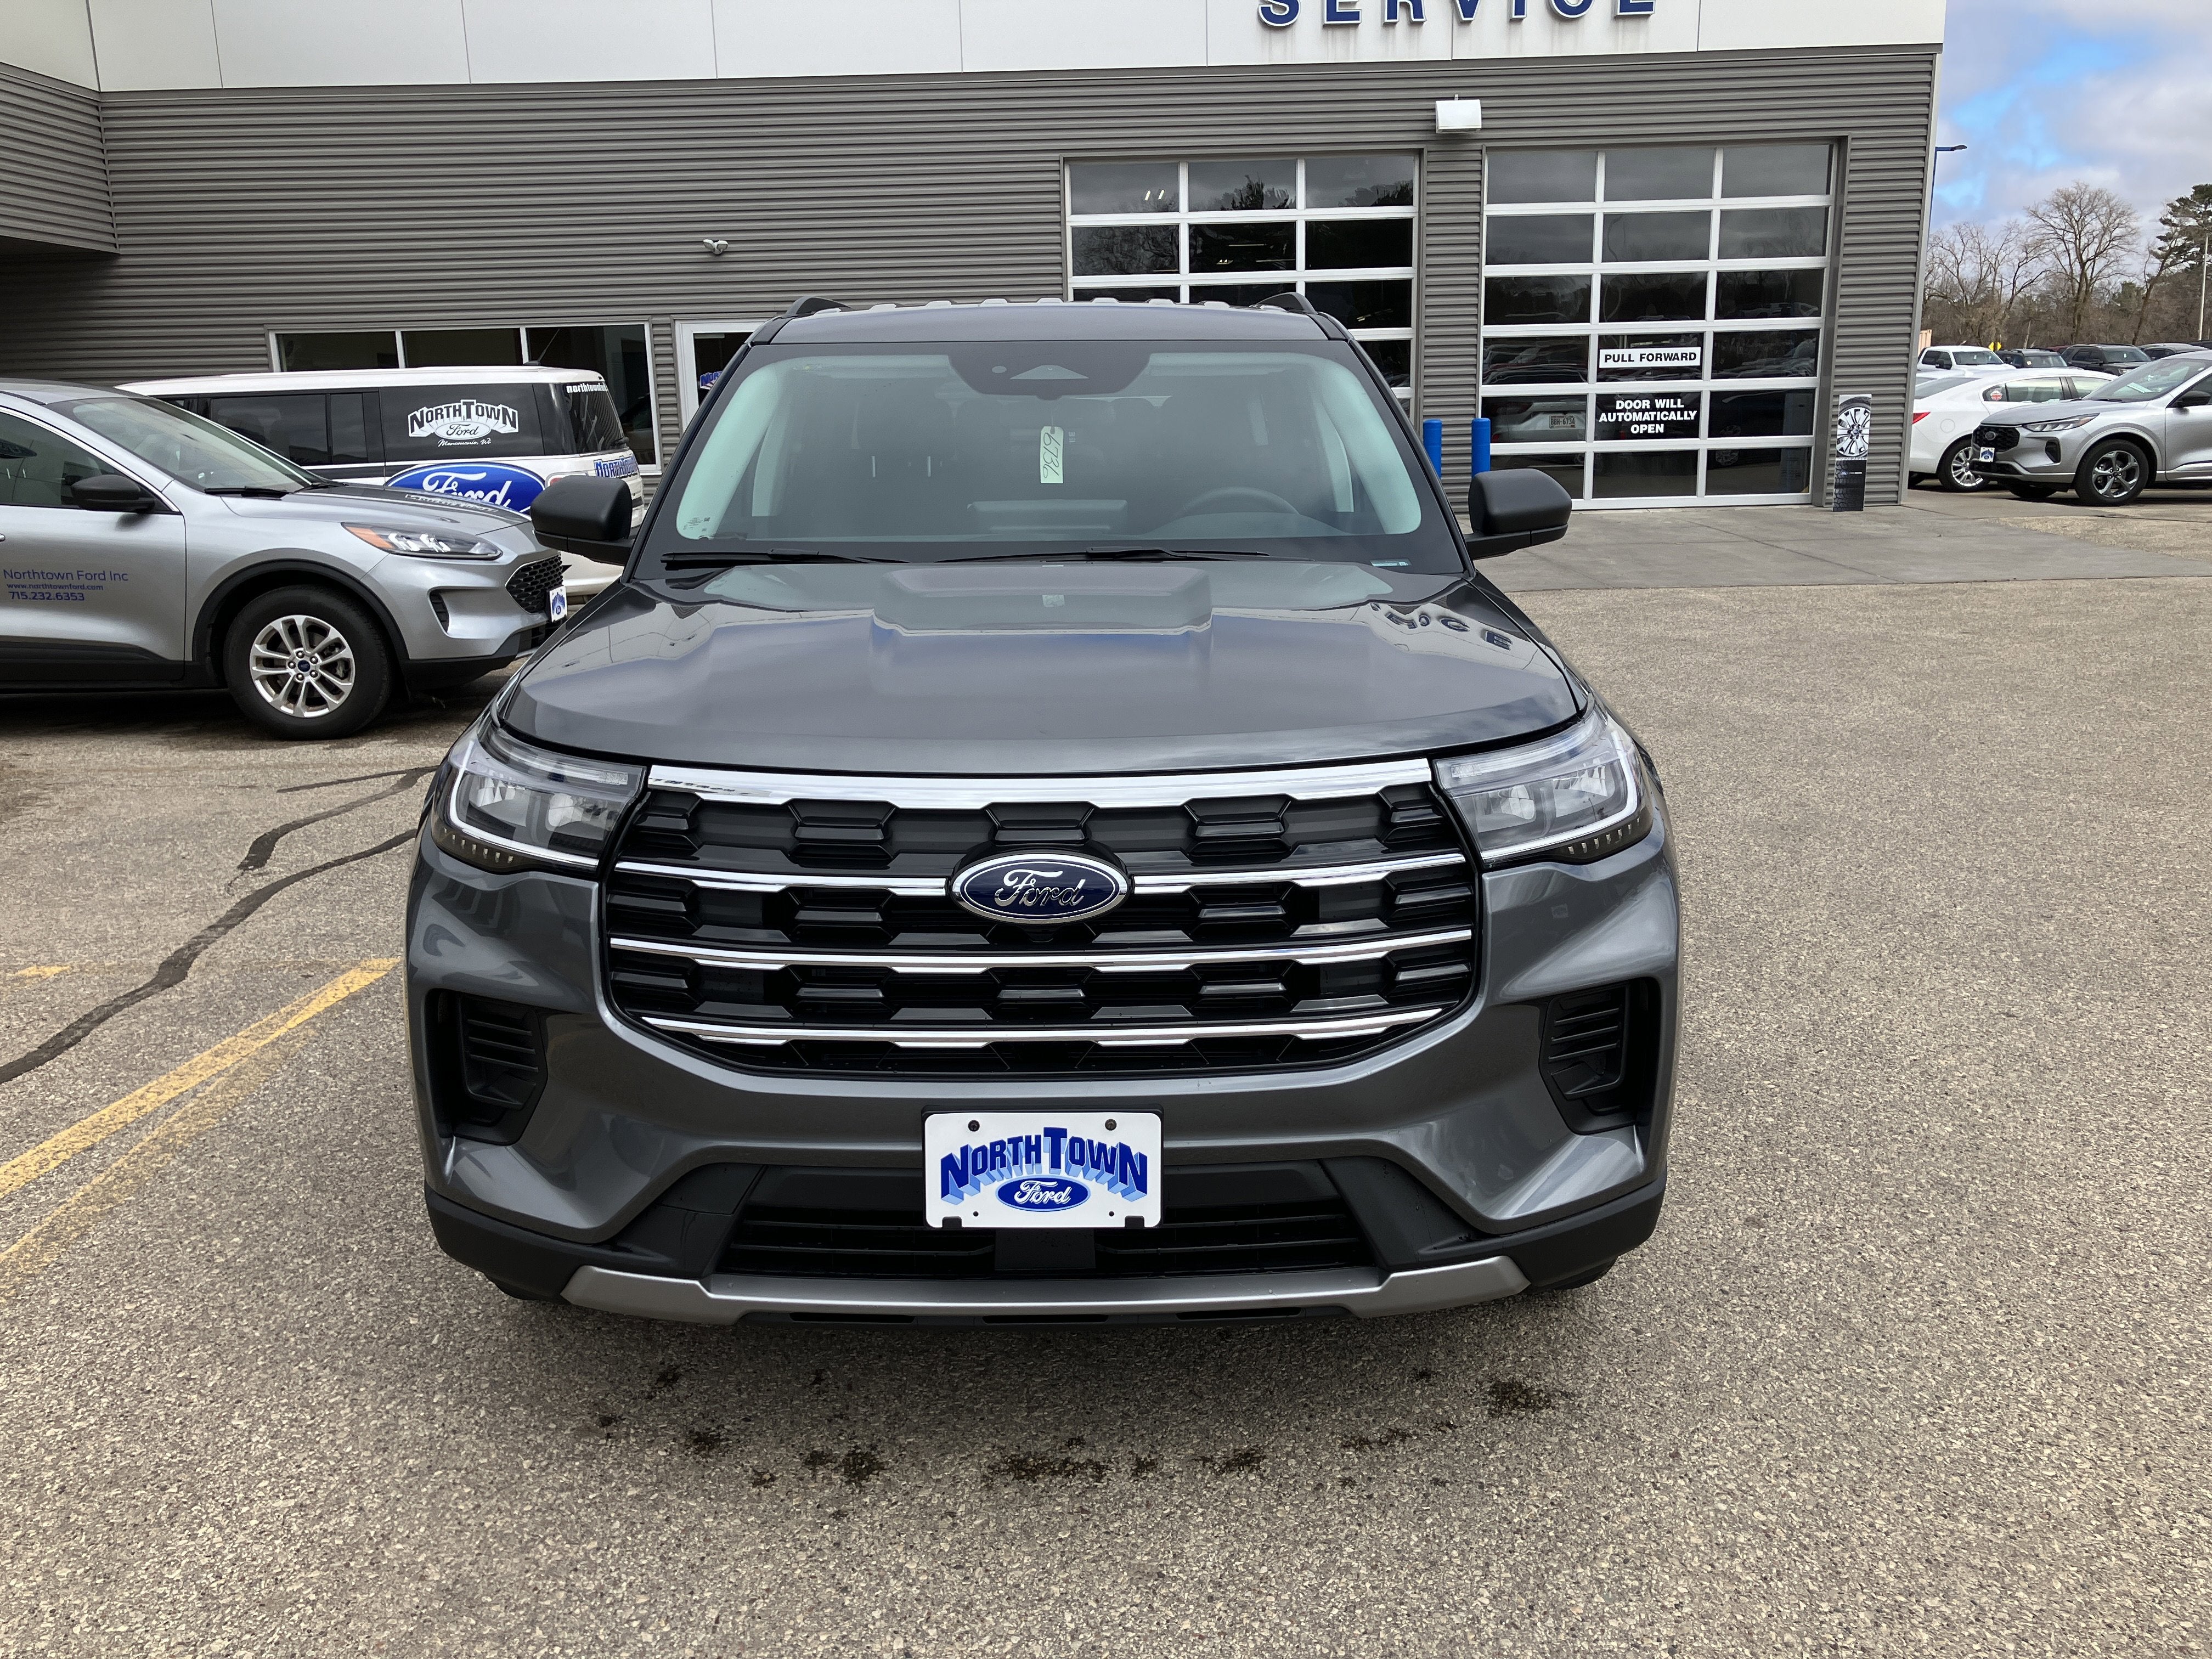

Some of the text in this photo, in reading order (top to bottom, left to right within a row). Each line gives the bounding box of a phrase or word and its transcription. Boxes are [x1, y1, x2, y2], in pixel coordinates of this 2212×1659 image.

[1604, 352, 1697, 363] PULL FORWARD
[1616, 399, 1684, 410] DOOR WILL
[1599, 410, 1697, 422] AUTOMATICALLY
[446, 424, 479, 436] Ford
[1630, 424, 1664, 433] OPEN
[1043, 432, 1061, 478] 6736
[3, 569, 129, 582] Northtown Ford Inc
[9, 591, 85, 601] 715.232.6353
[994, 868, 1086, 907] Ford
[1013, 1180, 1073, 1205] Ford
